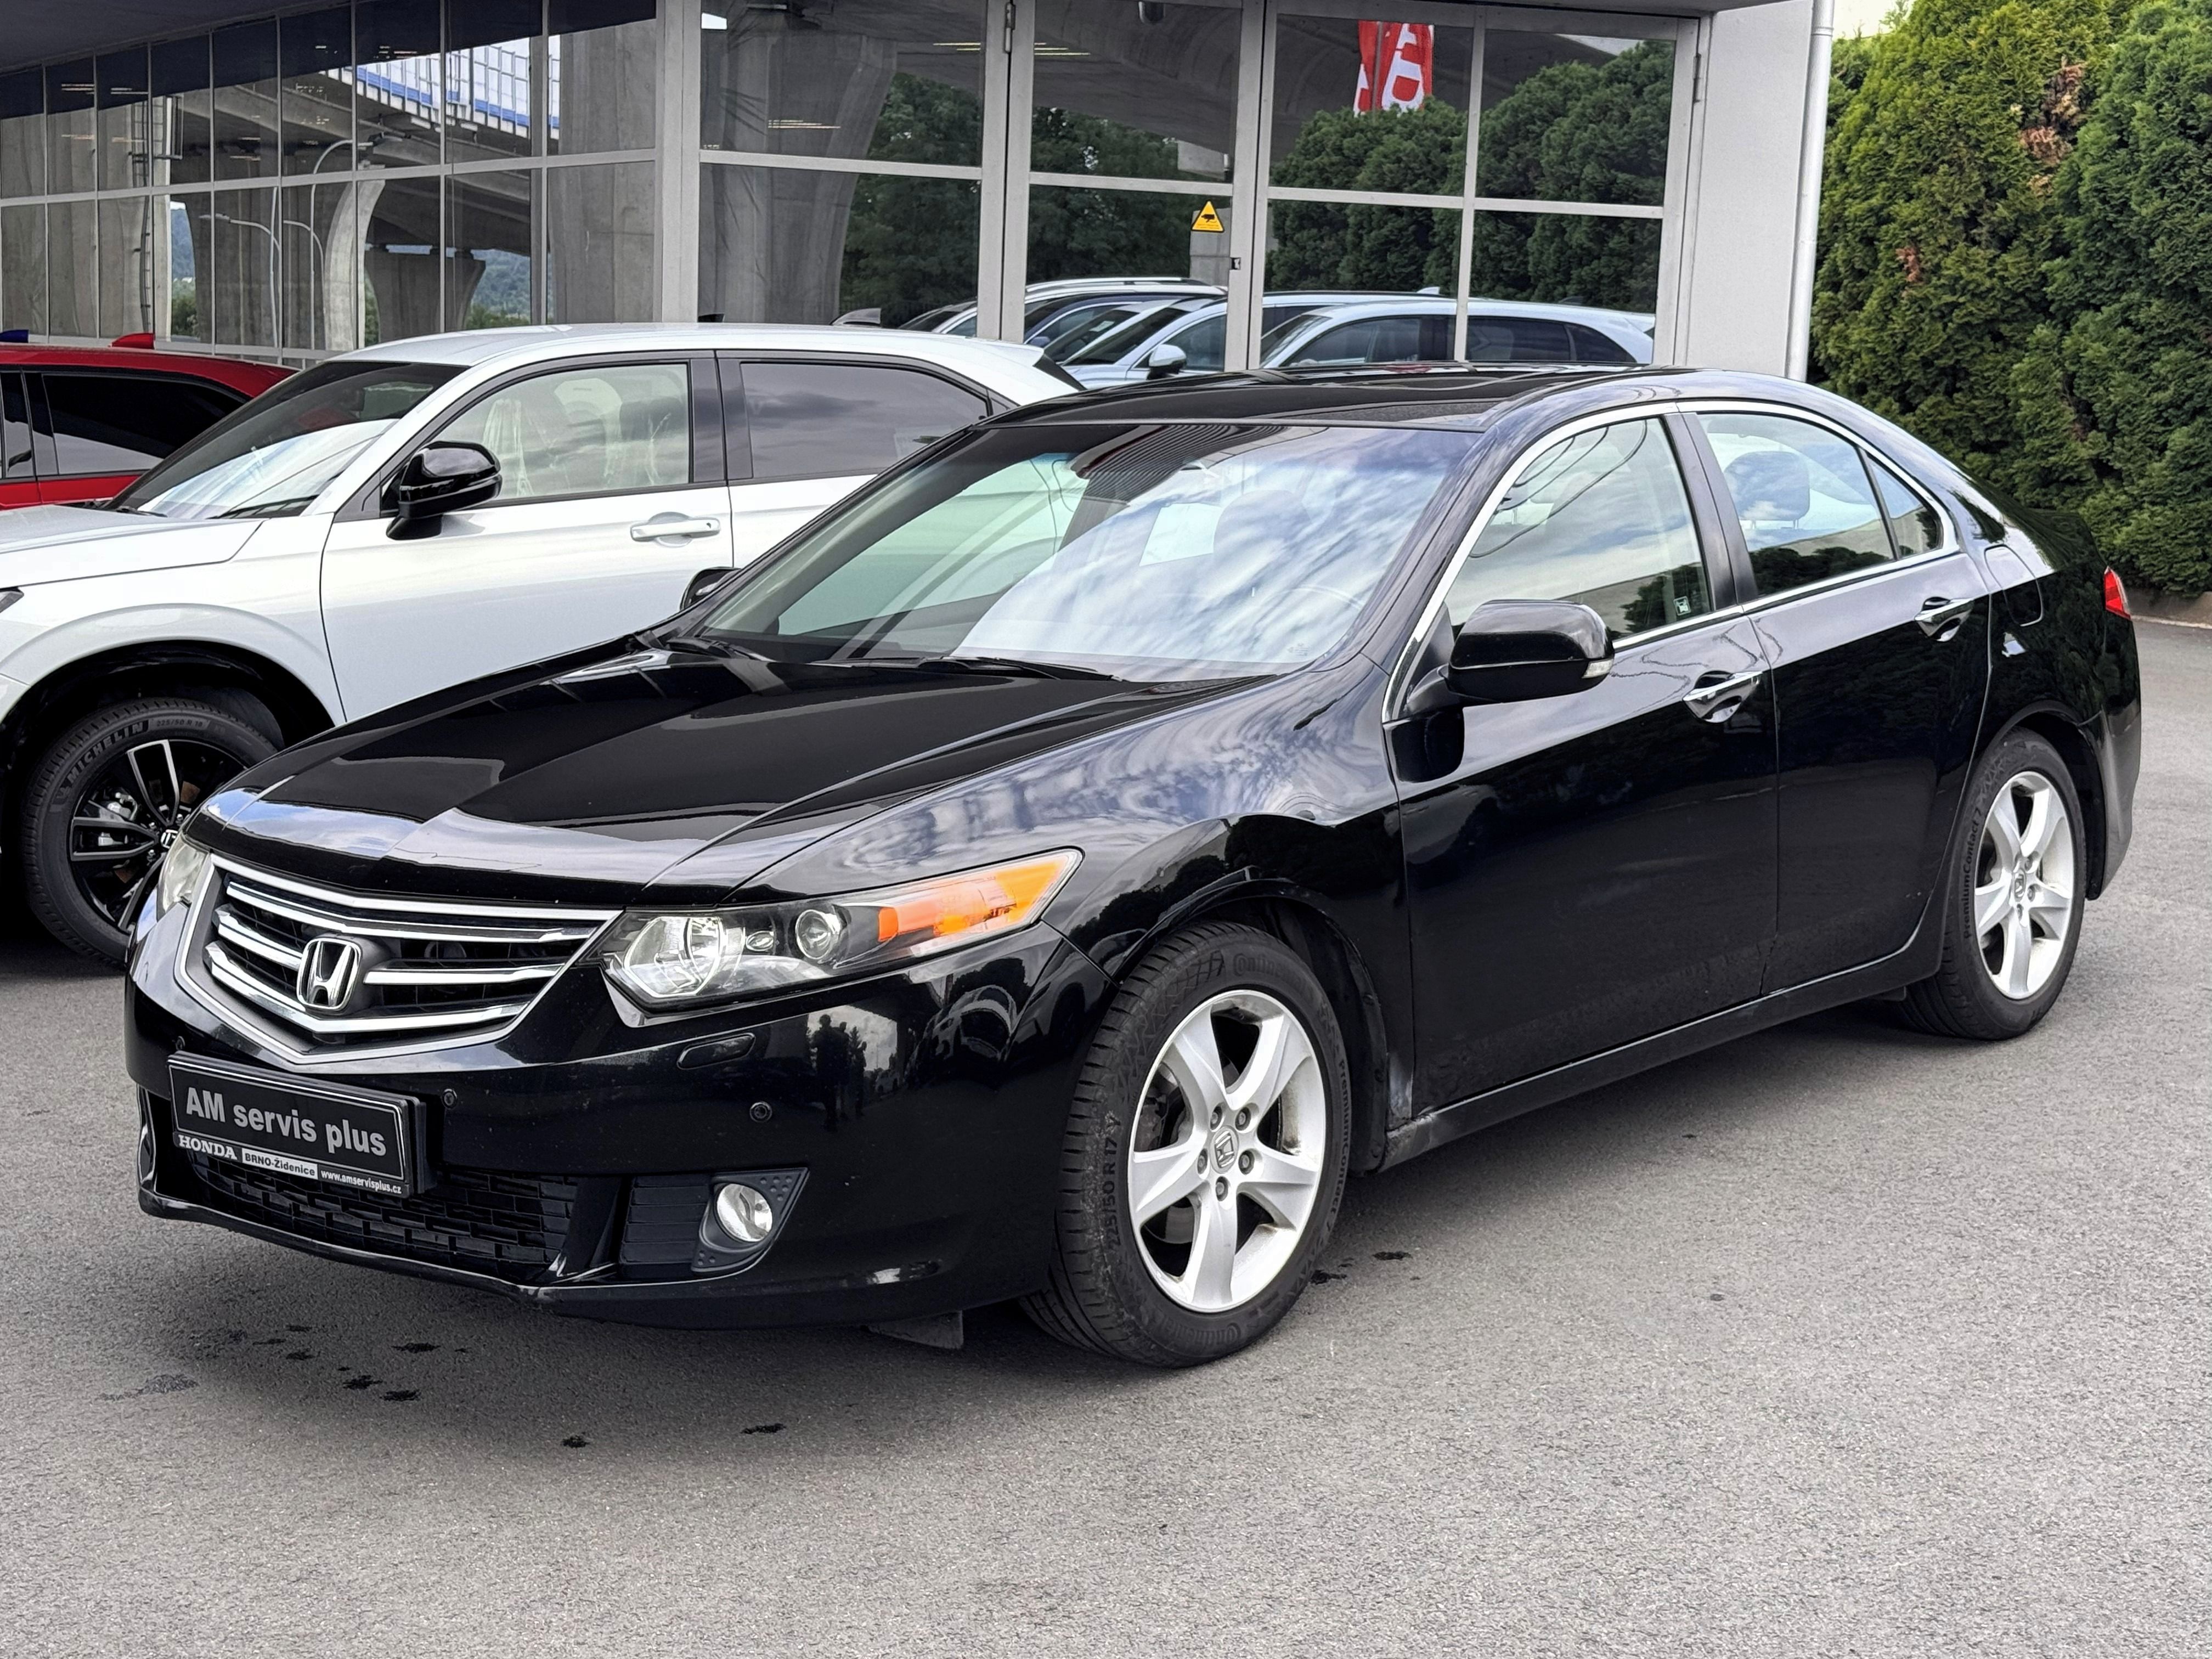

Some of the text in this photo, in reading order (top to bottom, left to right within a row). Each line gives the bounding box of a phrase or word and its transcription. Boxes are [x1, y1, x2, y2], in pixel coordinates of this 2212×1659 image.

[66, 721, 144, 782] MICHELIN
[156, 719, 185, 727] 225/50
[186, 1086, 386, 1156] AM servis plus
[1103, 1137, 1118, 1155] 17
[178, 1135, 402, 1194] HONDA BRNO-Židenice www.amservisplus.cz
[1102, 1161, 1116, 1175] R
[1102, 1181, 1121, 1250] 225/50
